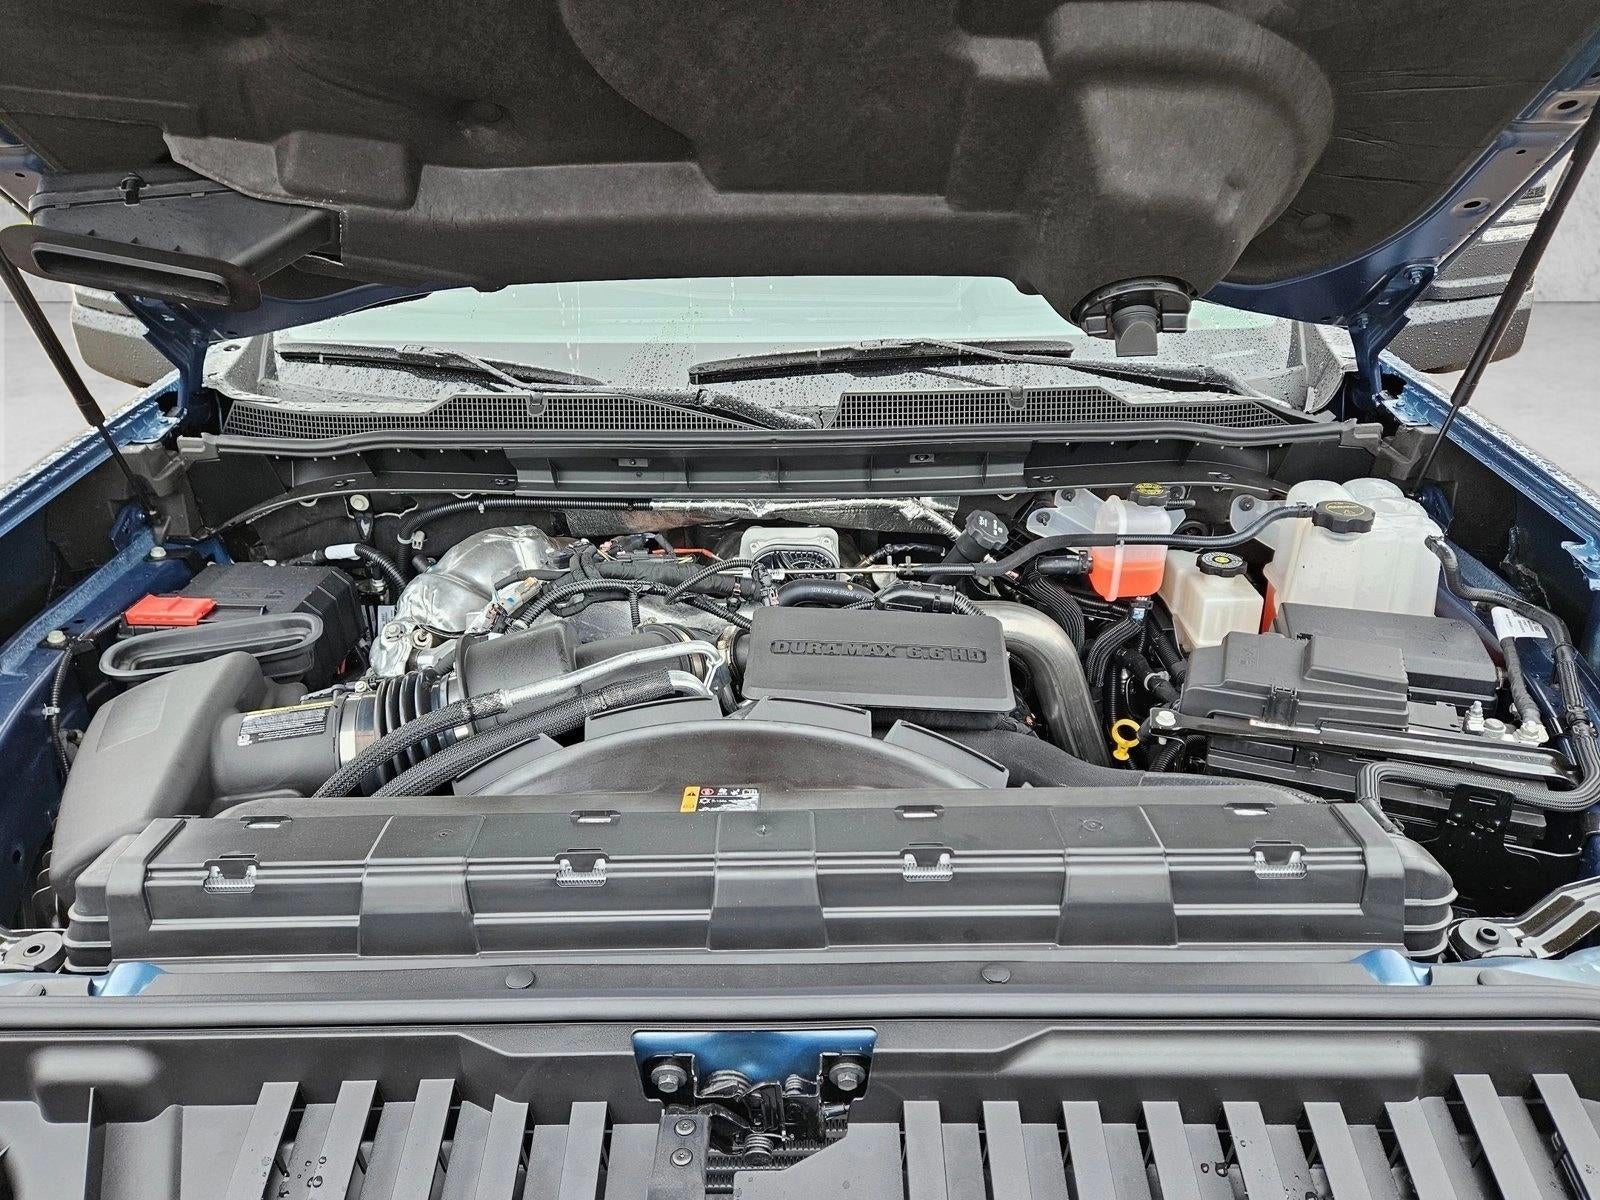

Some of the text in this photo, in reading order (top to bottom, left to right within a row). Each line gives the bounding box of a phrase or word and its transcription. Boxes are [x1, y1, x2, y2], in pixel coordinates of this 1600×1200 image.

[771, 640, 987, 663] DURAMAX 6.6 HD
